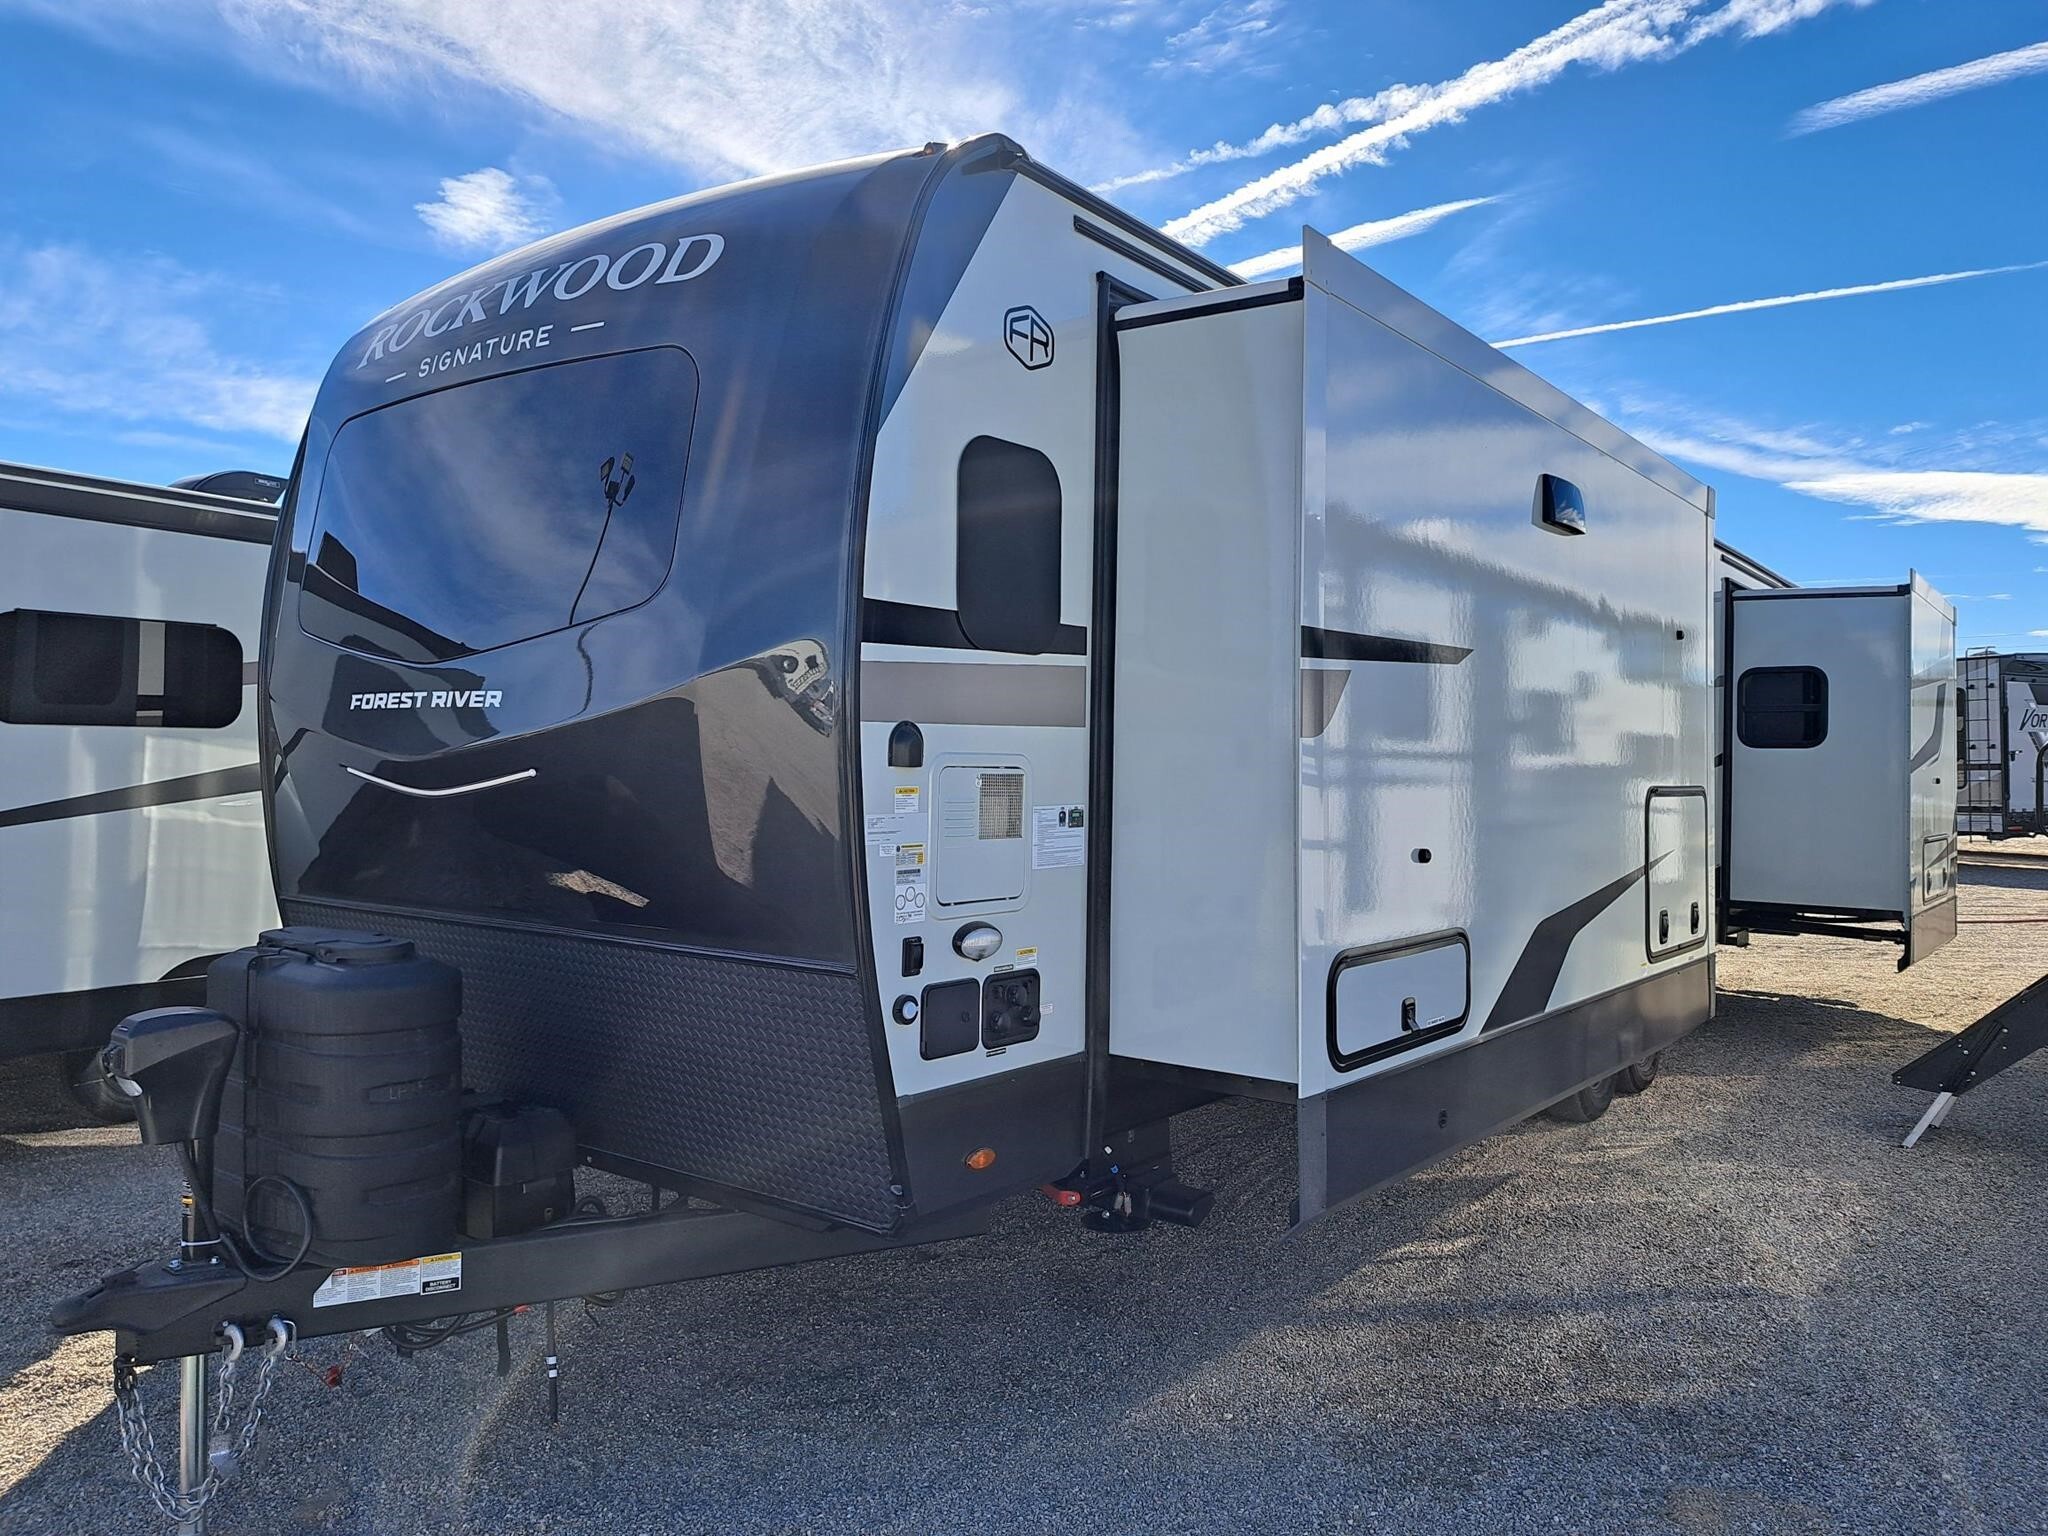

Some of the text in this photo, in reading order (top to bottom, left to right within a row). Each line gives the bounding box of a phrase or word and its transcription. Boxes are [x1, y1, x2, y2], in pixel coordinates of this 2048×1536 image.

[356, 233, 726, 370] ROCKWOOD
[418, 324, 554, 378] SIGNATURE
[350, 690, 503, 710] FOREST RIVER
